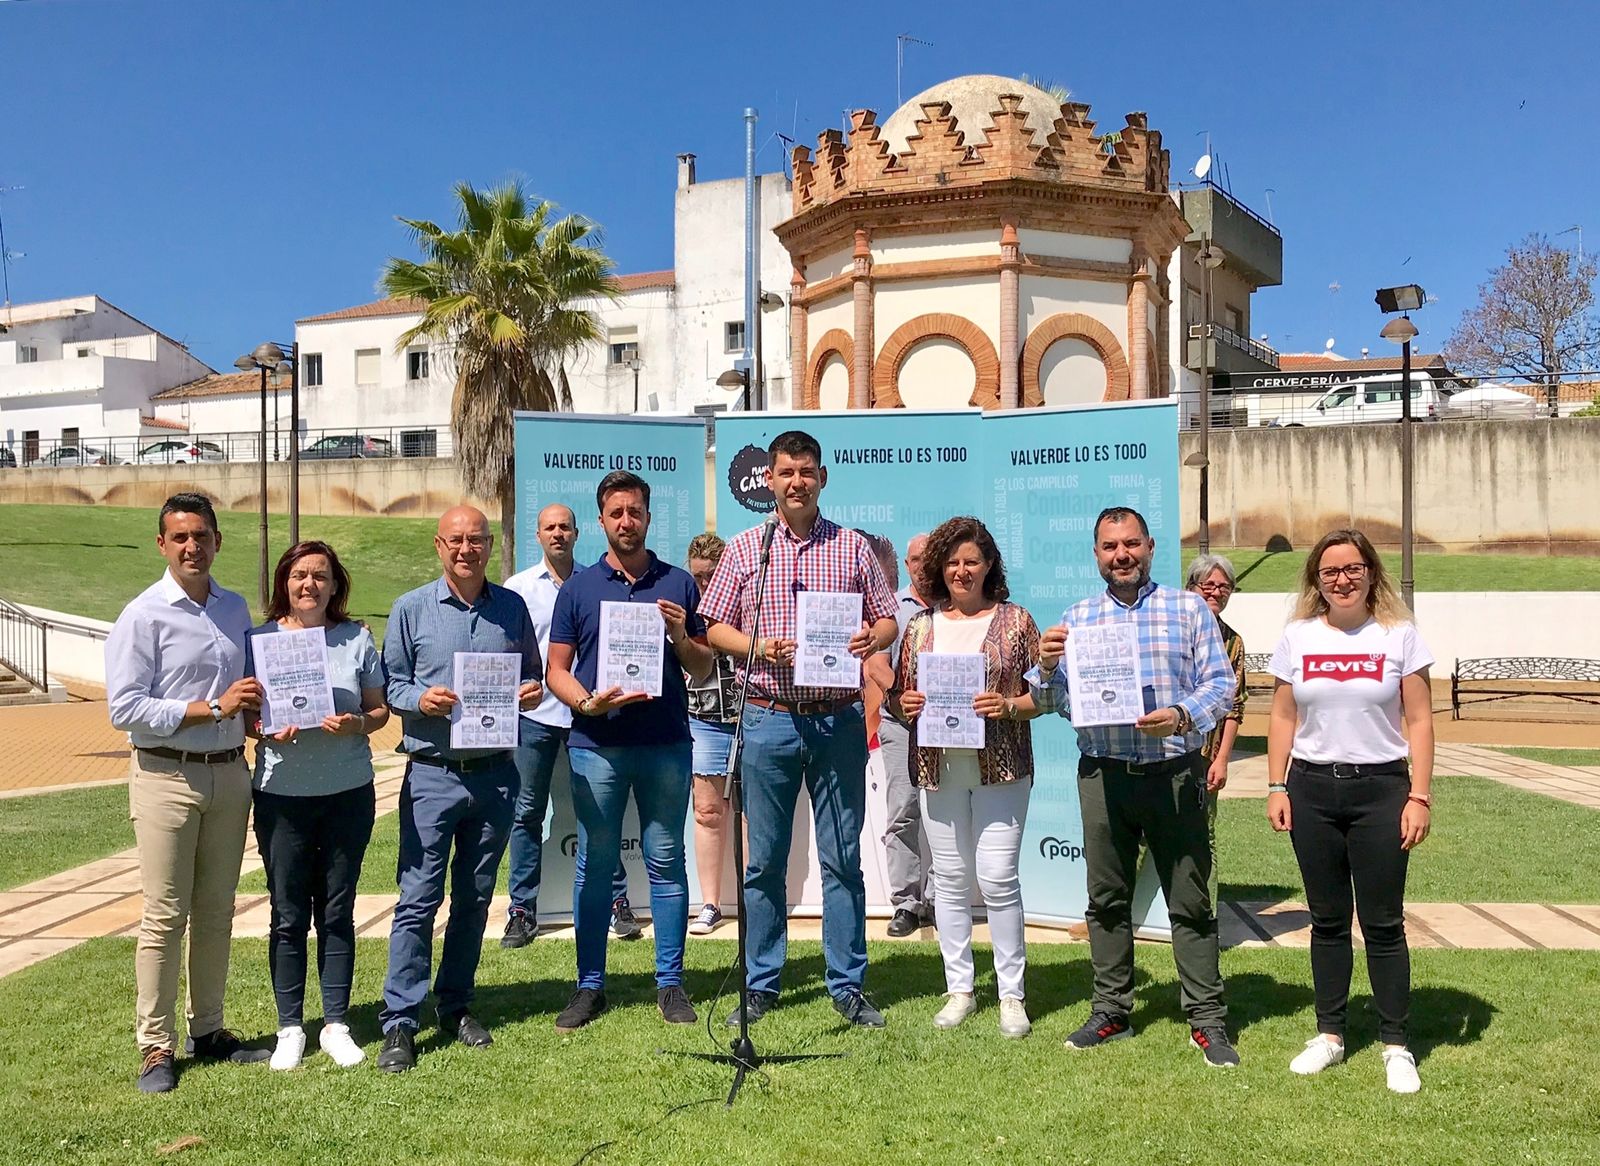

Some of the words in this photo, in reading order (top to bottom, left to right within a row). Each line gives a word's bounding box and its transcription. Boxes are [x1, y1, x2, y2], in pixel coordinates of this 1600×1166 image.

[1253, 373, 1342, 389] CERVECERÍA
[544, 452, 605, 470] VALVERDE
[609, 454, 624, 470] LO
[627, 455, 643, 471] ES
[646, 456, 677, 472] TODO
[834, 448, 894, 464] VALVERDE
[898, 447, 913, 463] LO
[916, 447, 932, 463] ES
[936, 446, 968, 463] TODO
[1010, 447, 1071, 466] VALVERDE
[1075, 445, 1090, 463] LO
[1094, 444, 1109, 462] ES
[1113, 442, 1147, 461] TODO
[539, 479, 558, 493] LOS
[739, 475, 768, 493] CAYU
[1008, 477, 1025, 491] LOS
[1027, 474, 1079, 490] CAMPILLOS
[1108, 474, 1145, 488] TRIANA
[525, 479, 538, 515] TABLAS
[994, 478, 1007, 514] TABLAS
[1148, 478, 1162, 508] PINOS
[677, 489, 690, 518] PINOS
[656, 503, 670, 538] MOLINO
[825, 503, 895, 523] VALVERDE
[1148, 511, 1162, 530] LOS
[526, 518, 538, 536] LAS
[677, 520, 690, 537] LOS
[995, 517, 1008, 535] LAS
[1049, 518, 1084, 532] PUERTO
[1010, 512, 1024, 569] ARRABALES
[1030, 584, 1055, 598] CRUZ
[1057, 584, 1070, 598] DE
[1049, 843, 1087, 862] popu
